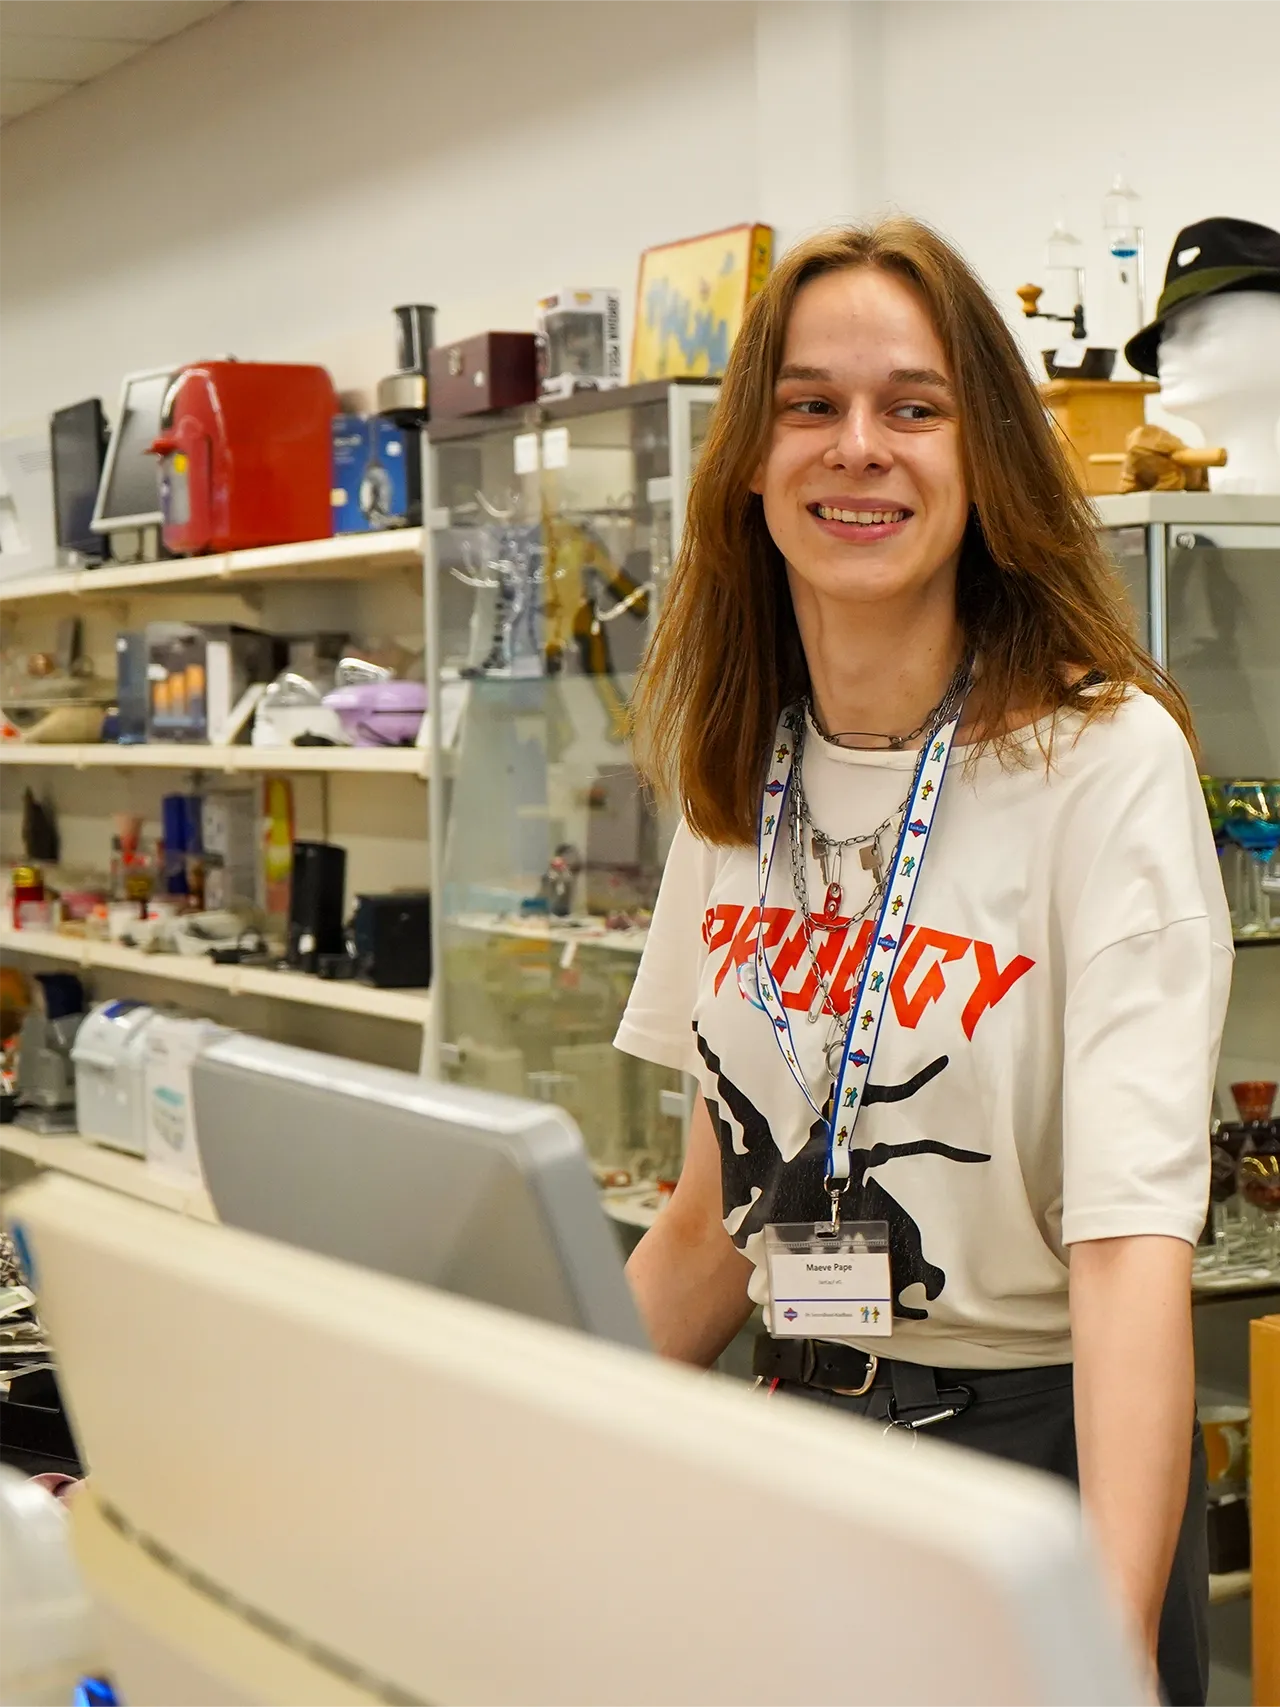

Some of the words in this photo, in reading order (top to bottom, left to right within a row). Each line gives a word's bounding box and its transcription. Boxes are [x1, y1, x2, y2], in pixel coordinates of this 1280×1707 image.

[708, 904, 1036, 1042] PRODGY
[806, 1263, 832, 1272] Maeve
[834, 1263, 853, 1273] Pape
